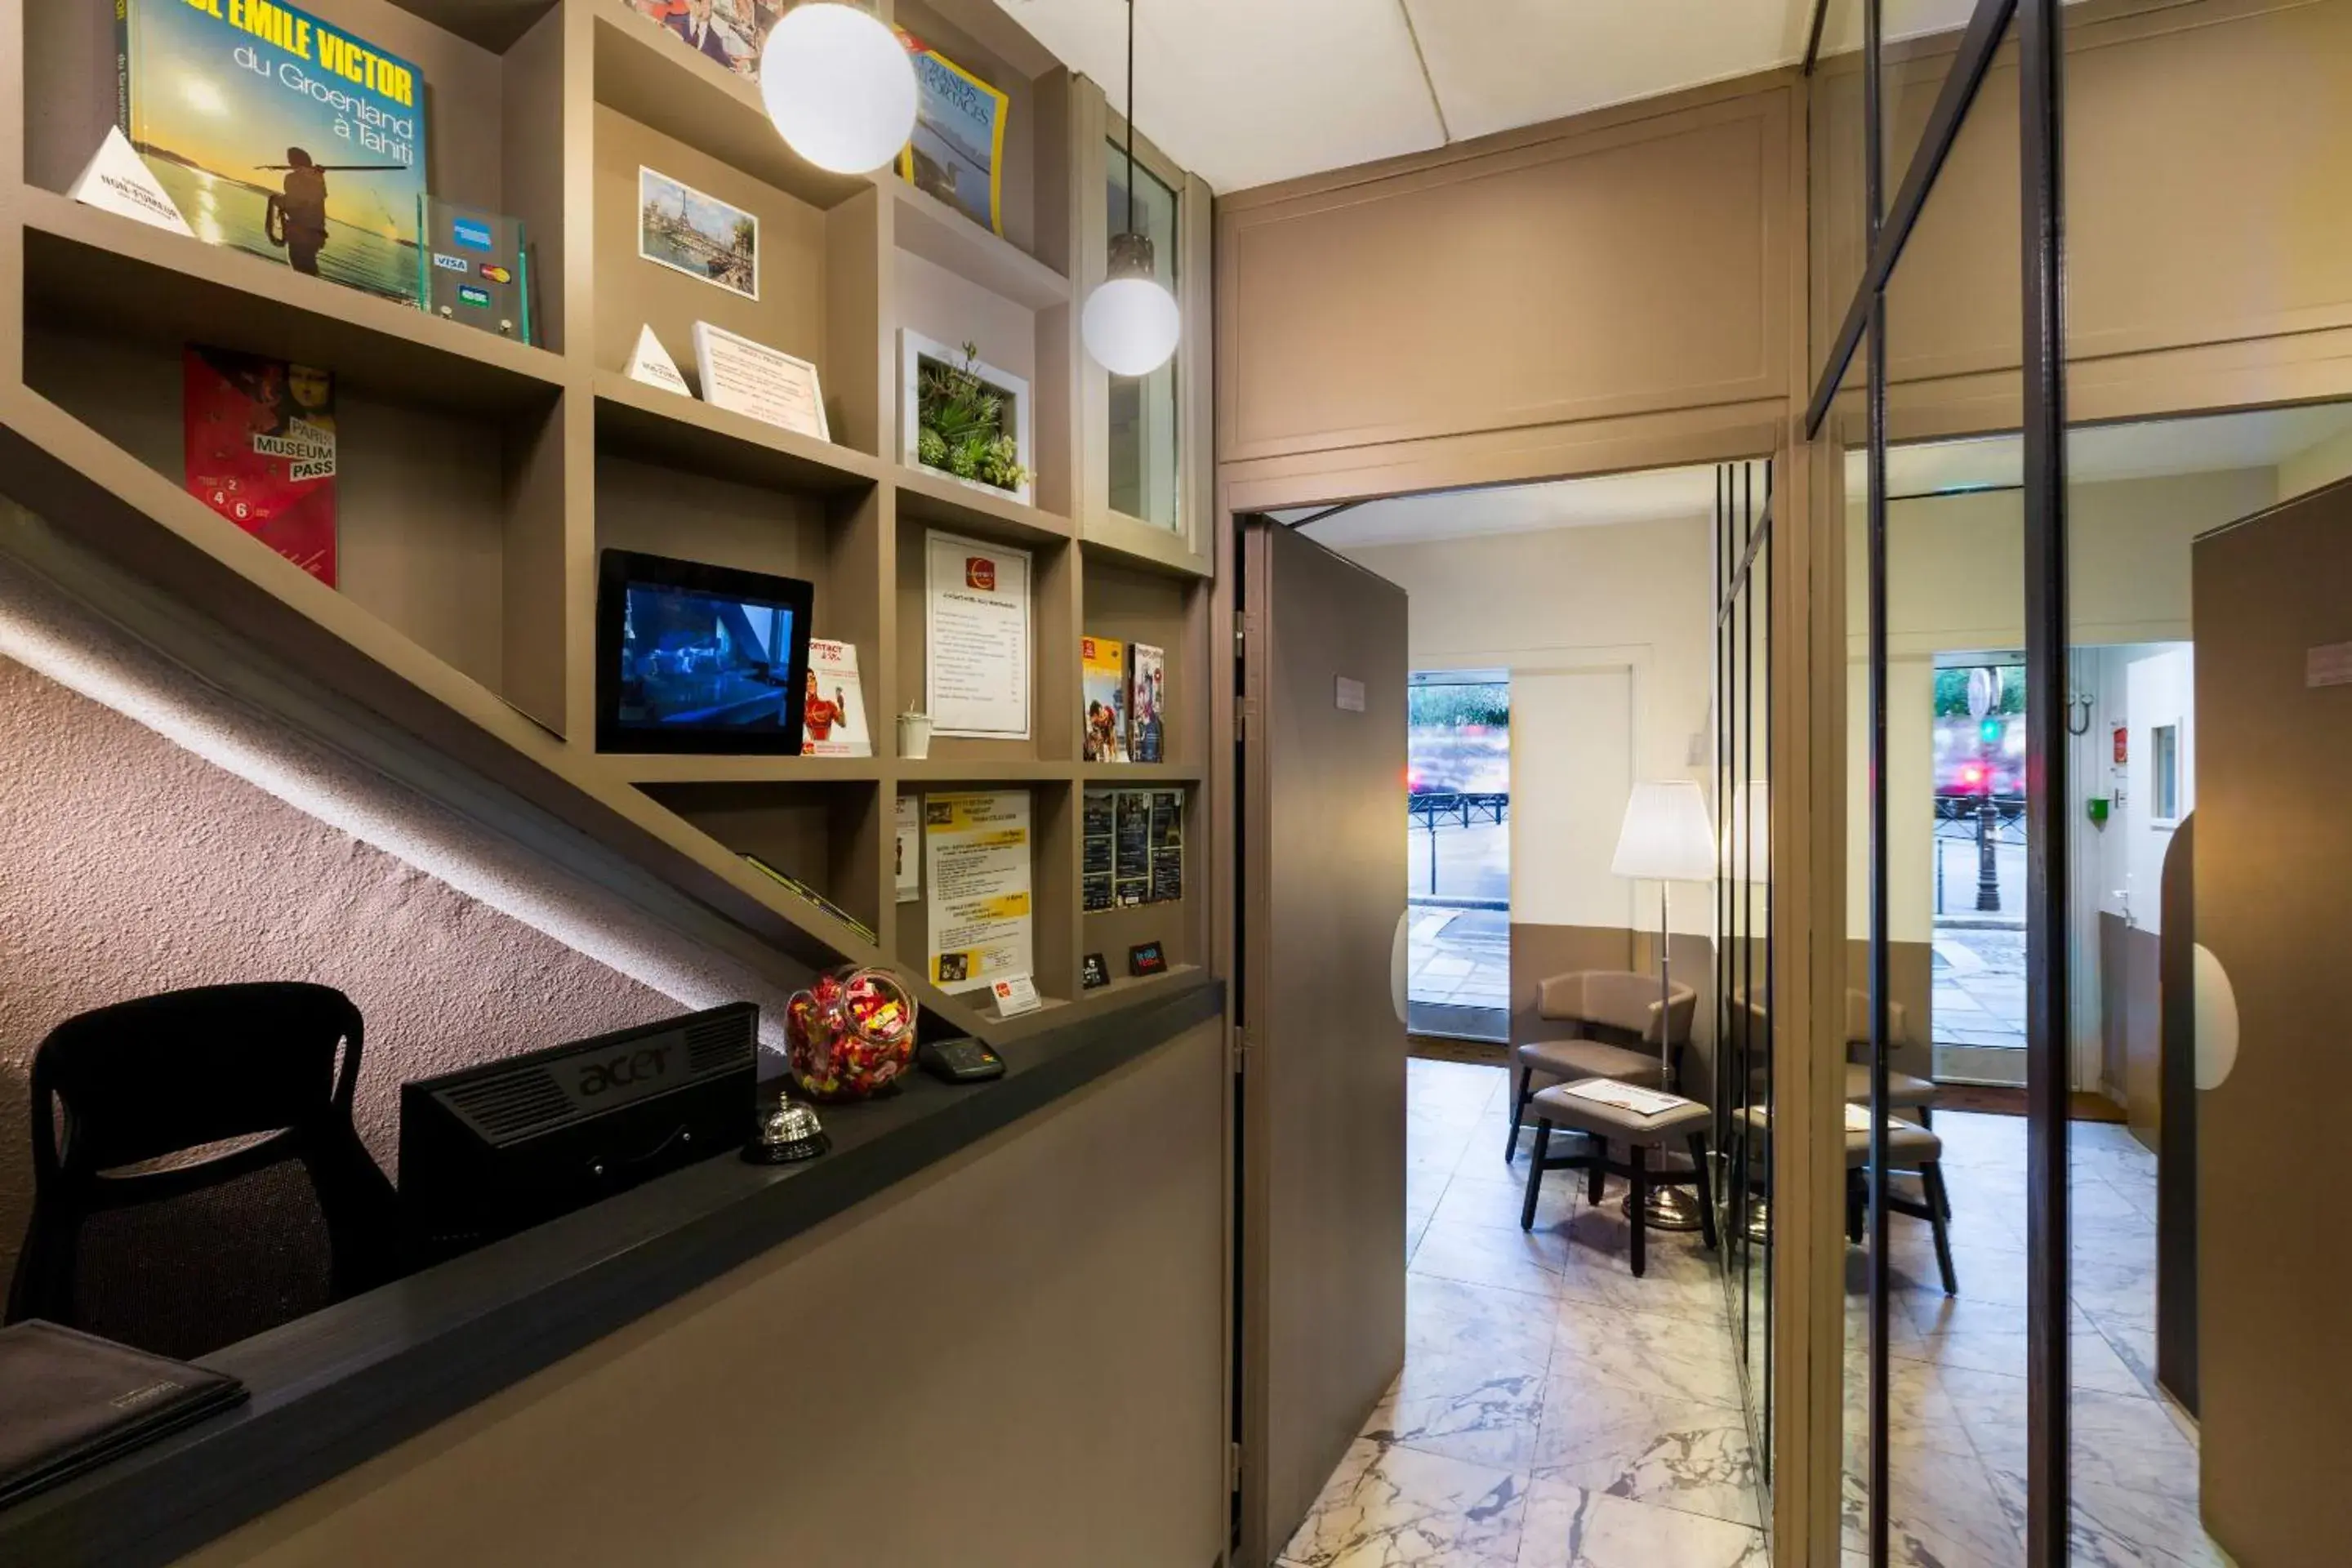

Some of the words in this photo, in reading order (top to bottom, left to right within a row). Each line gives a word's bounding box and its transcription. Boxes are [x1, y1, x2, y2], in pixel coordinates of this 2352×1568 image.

[229, 0, 311, 60] EMILE
[317, 28, 412, 107] VICTOR
[234, 46, 270, 78] du
[279, 63, 412, 140] Groenland
[333, 113, 352, 139] à
[354, 119, 412, 165] Tahiti
[438, 257, 466, 270] VISA
[292, 420, 332, 446] PARIS
[256, 436, 332, 459] MUSEUM
[292, 461, 333, 478] PASS
[228, 479, 237, 490] 2
[214, 492, 225, 505] 4
[236, 502, 247, 519] 6
[579, 1042, 672, 1096] acer
